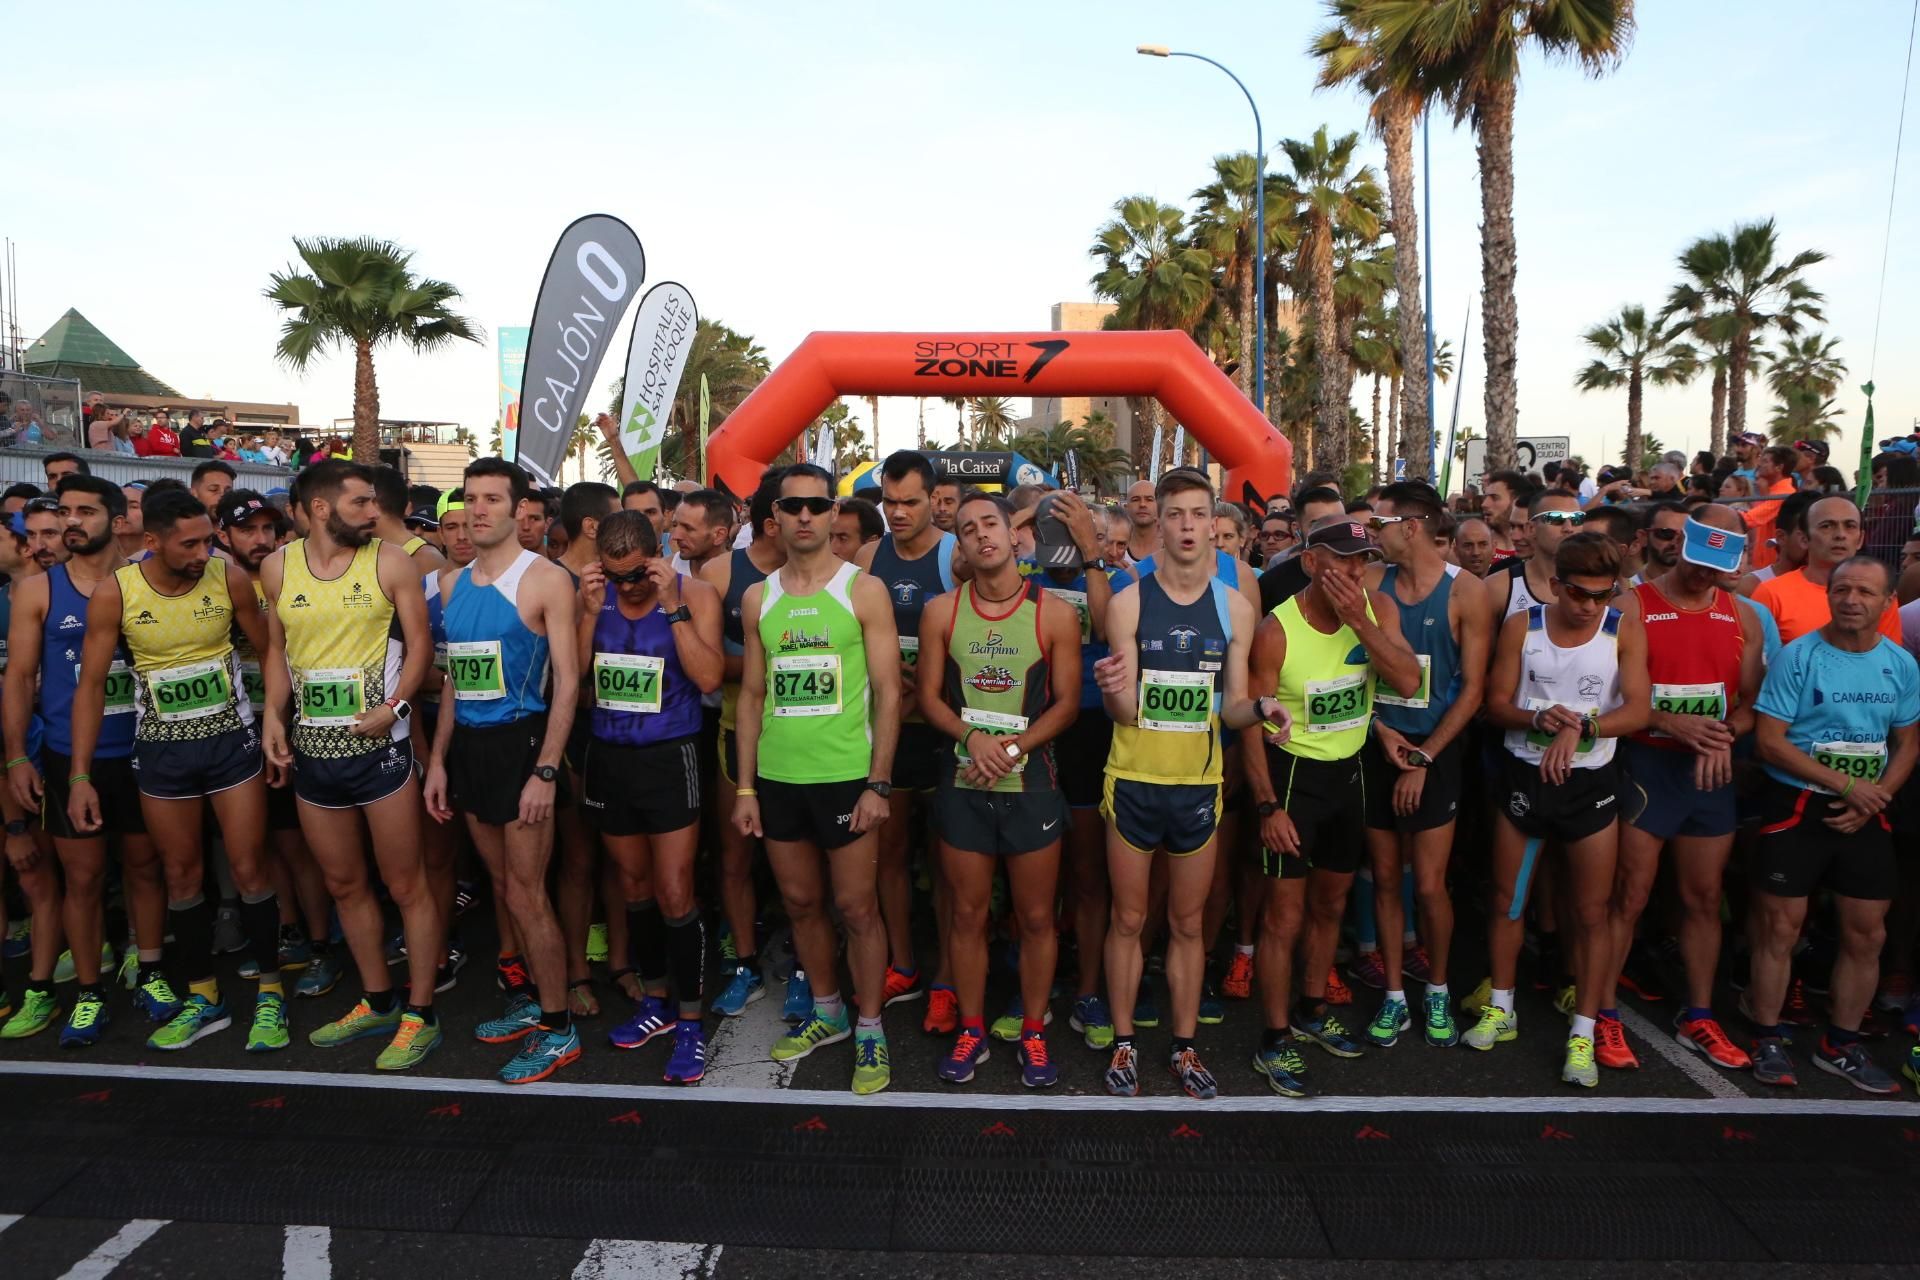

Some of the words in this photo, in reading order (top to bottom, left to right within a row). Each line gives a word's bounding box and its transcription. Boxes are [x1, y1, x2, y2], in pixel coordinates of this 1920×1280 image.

[639, 293, 679, 404] HOSPITALES
[914, 341, 1020, 358] SPORT
[534, 296, 605, 432] CAJÓN
[653, 379, 668, 417] SAN
[664, 306, 692, 374] ROQUE
[914, 358, 1018, 378] ZONE
[1535, 442, 1566, 451] CENTRO
[1536, 450, 1565, 458] CIUDAD
[342, 593, 373, 603] HPS
[193, 604, 225, 618] HPS
[1709, 612, 1736, 624] ESPAÑA
[968, 641, 1019, 660] Barpimo
[450, 657, 496, 681] 8797
[599, 668, 657, 693] 6047
[157, 674, 223, 704] 6001
[774, 671, 835, 696] 8749
[303, 684, 355, 707] 9511
[1145, 687, 1208, 711] 6002
[1311, 683, 1367, 716] 6237
[1658, 698, 1721, 719] 8444
[1817, 754, 1881, 779] 8893
